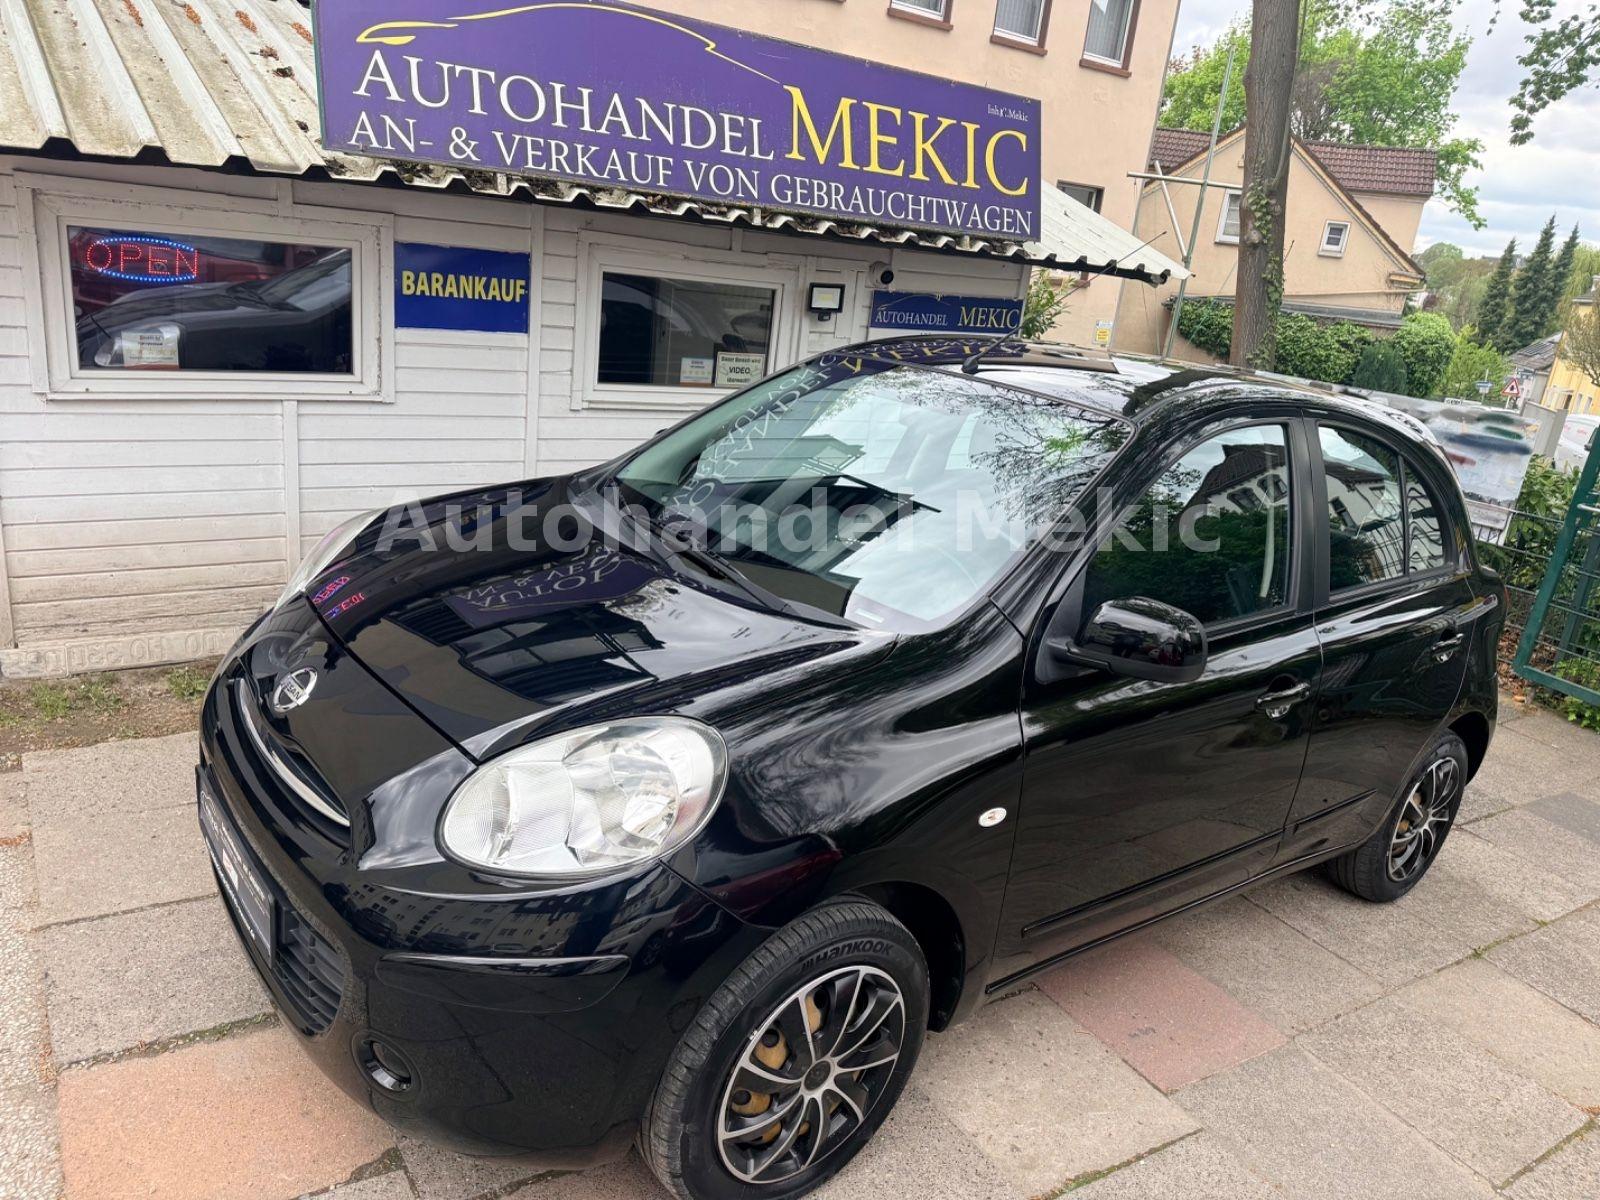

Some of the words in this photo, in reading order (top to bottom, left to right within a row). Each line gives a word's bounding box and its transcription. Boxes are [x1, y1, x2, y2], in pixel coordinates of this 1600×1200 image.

[353, 50, 774, 161] AUTOHANDEL
[783, 84, 1028, 196] MEKIC
[347, 111, 433, 153] AN-
[448, 127, 481, 161] &
[492, 131, 674, 187] VERKAUF
[683, 159, 760, 200] VON
[770, 174, 1032, 235] GEBRAUCHTWAGEN
[86, 240, 198, 278] OPEN
[402, 270, 526, 303] BARANKAUF
[875, 310, 948, 326] AUTOHANDEL
[957, 306, 1020, 329] MEKIC
[729, 366, 751, 374] VIDEO
